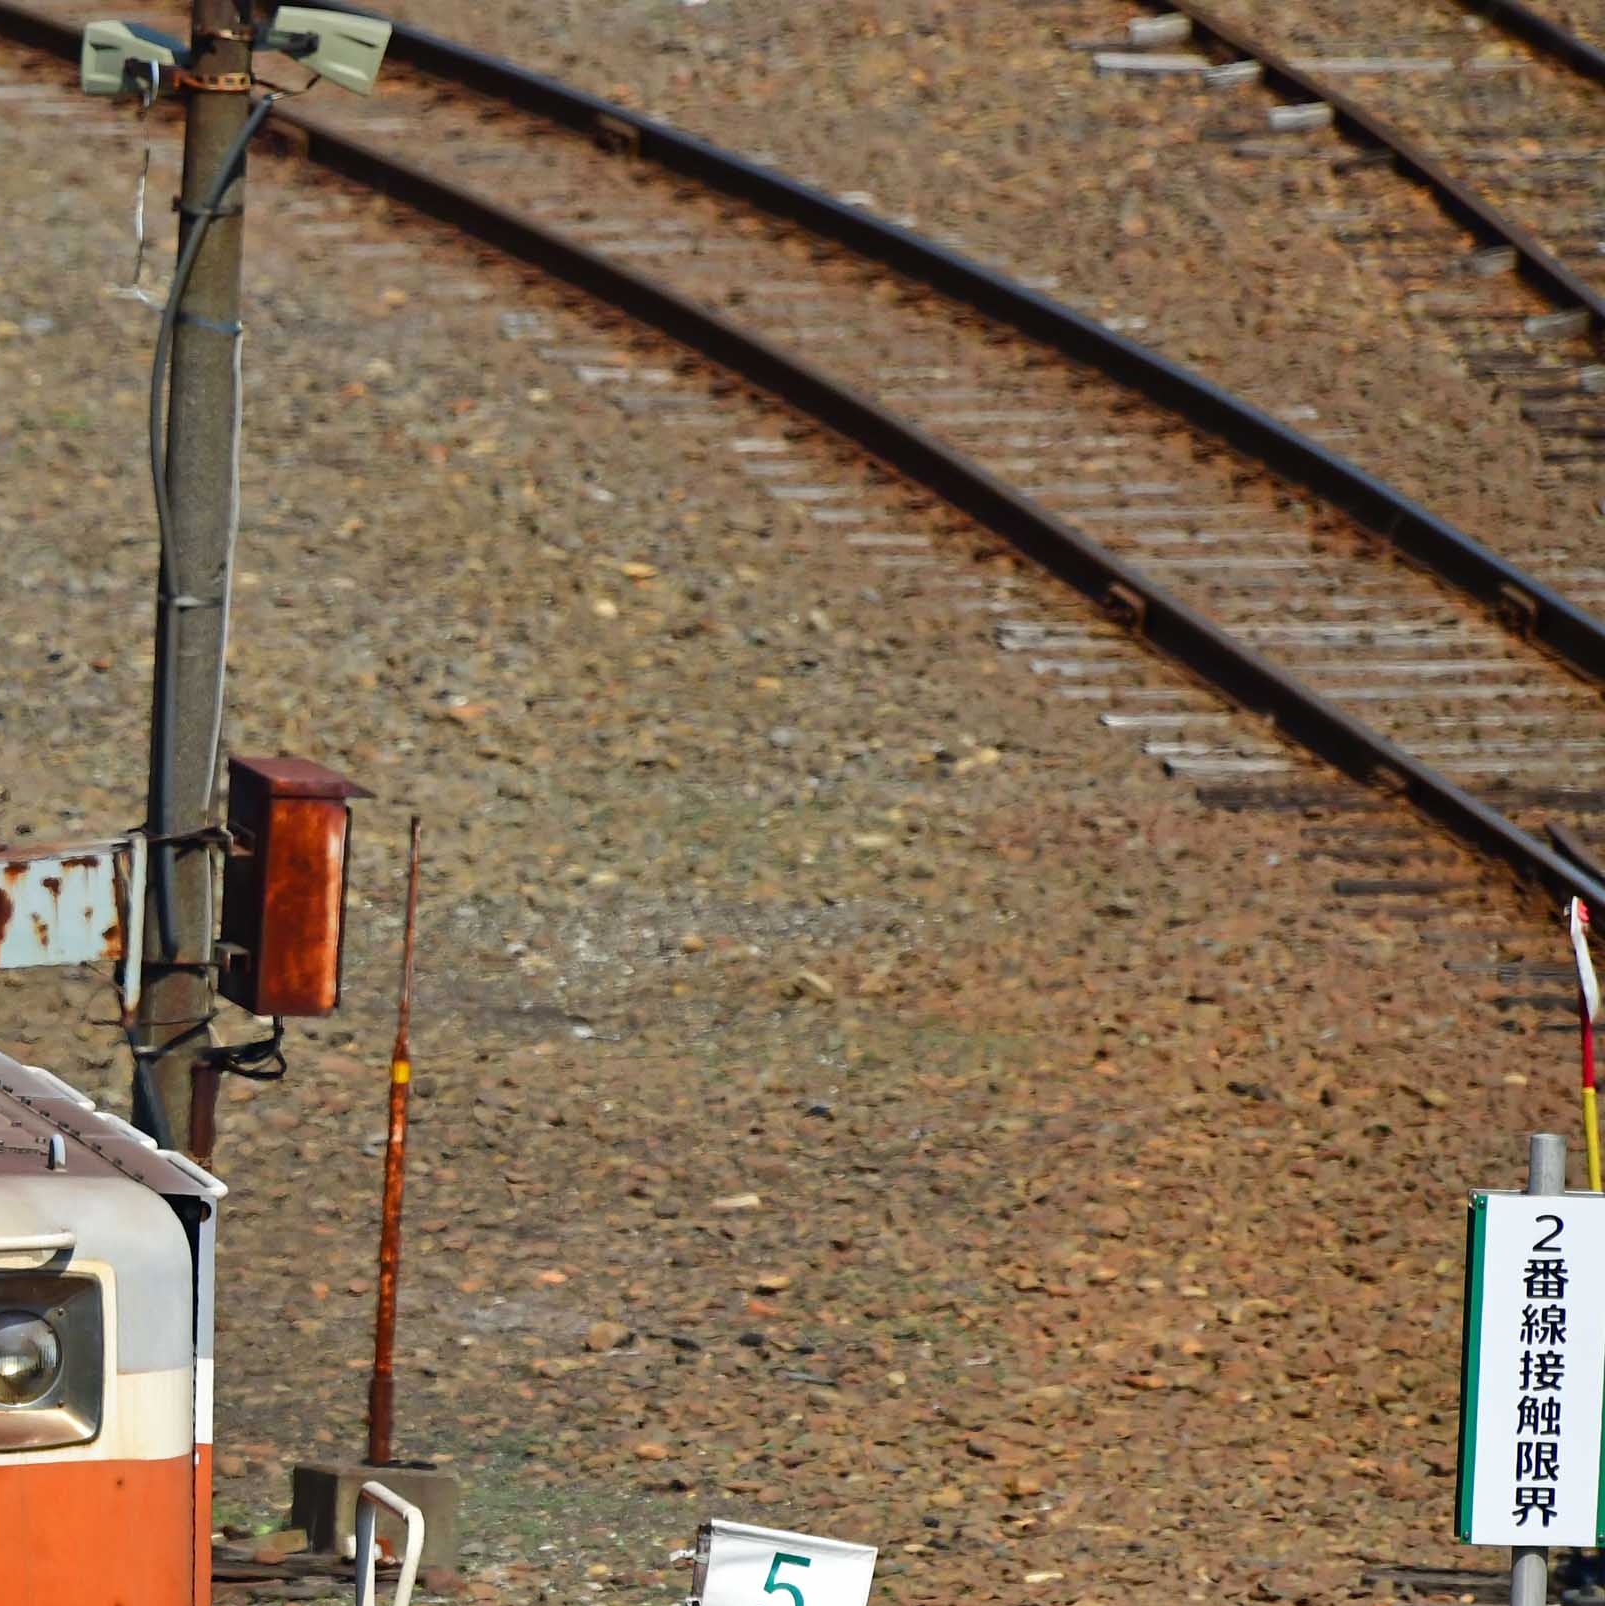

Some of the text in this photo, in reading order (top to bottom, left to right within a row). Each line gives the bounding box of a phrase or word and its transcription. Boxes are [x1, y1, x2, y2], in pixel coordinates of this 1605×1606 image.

[1512, 1214, 1569, 1528] 2番線接触限界
